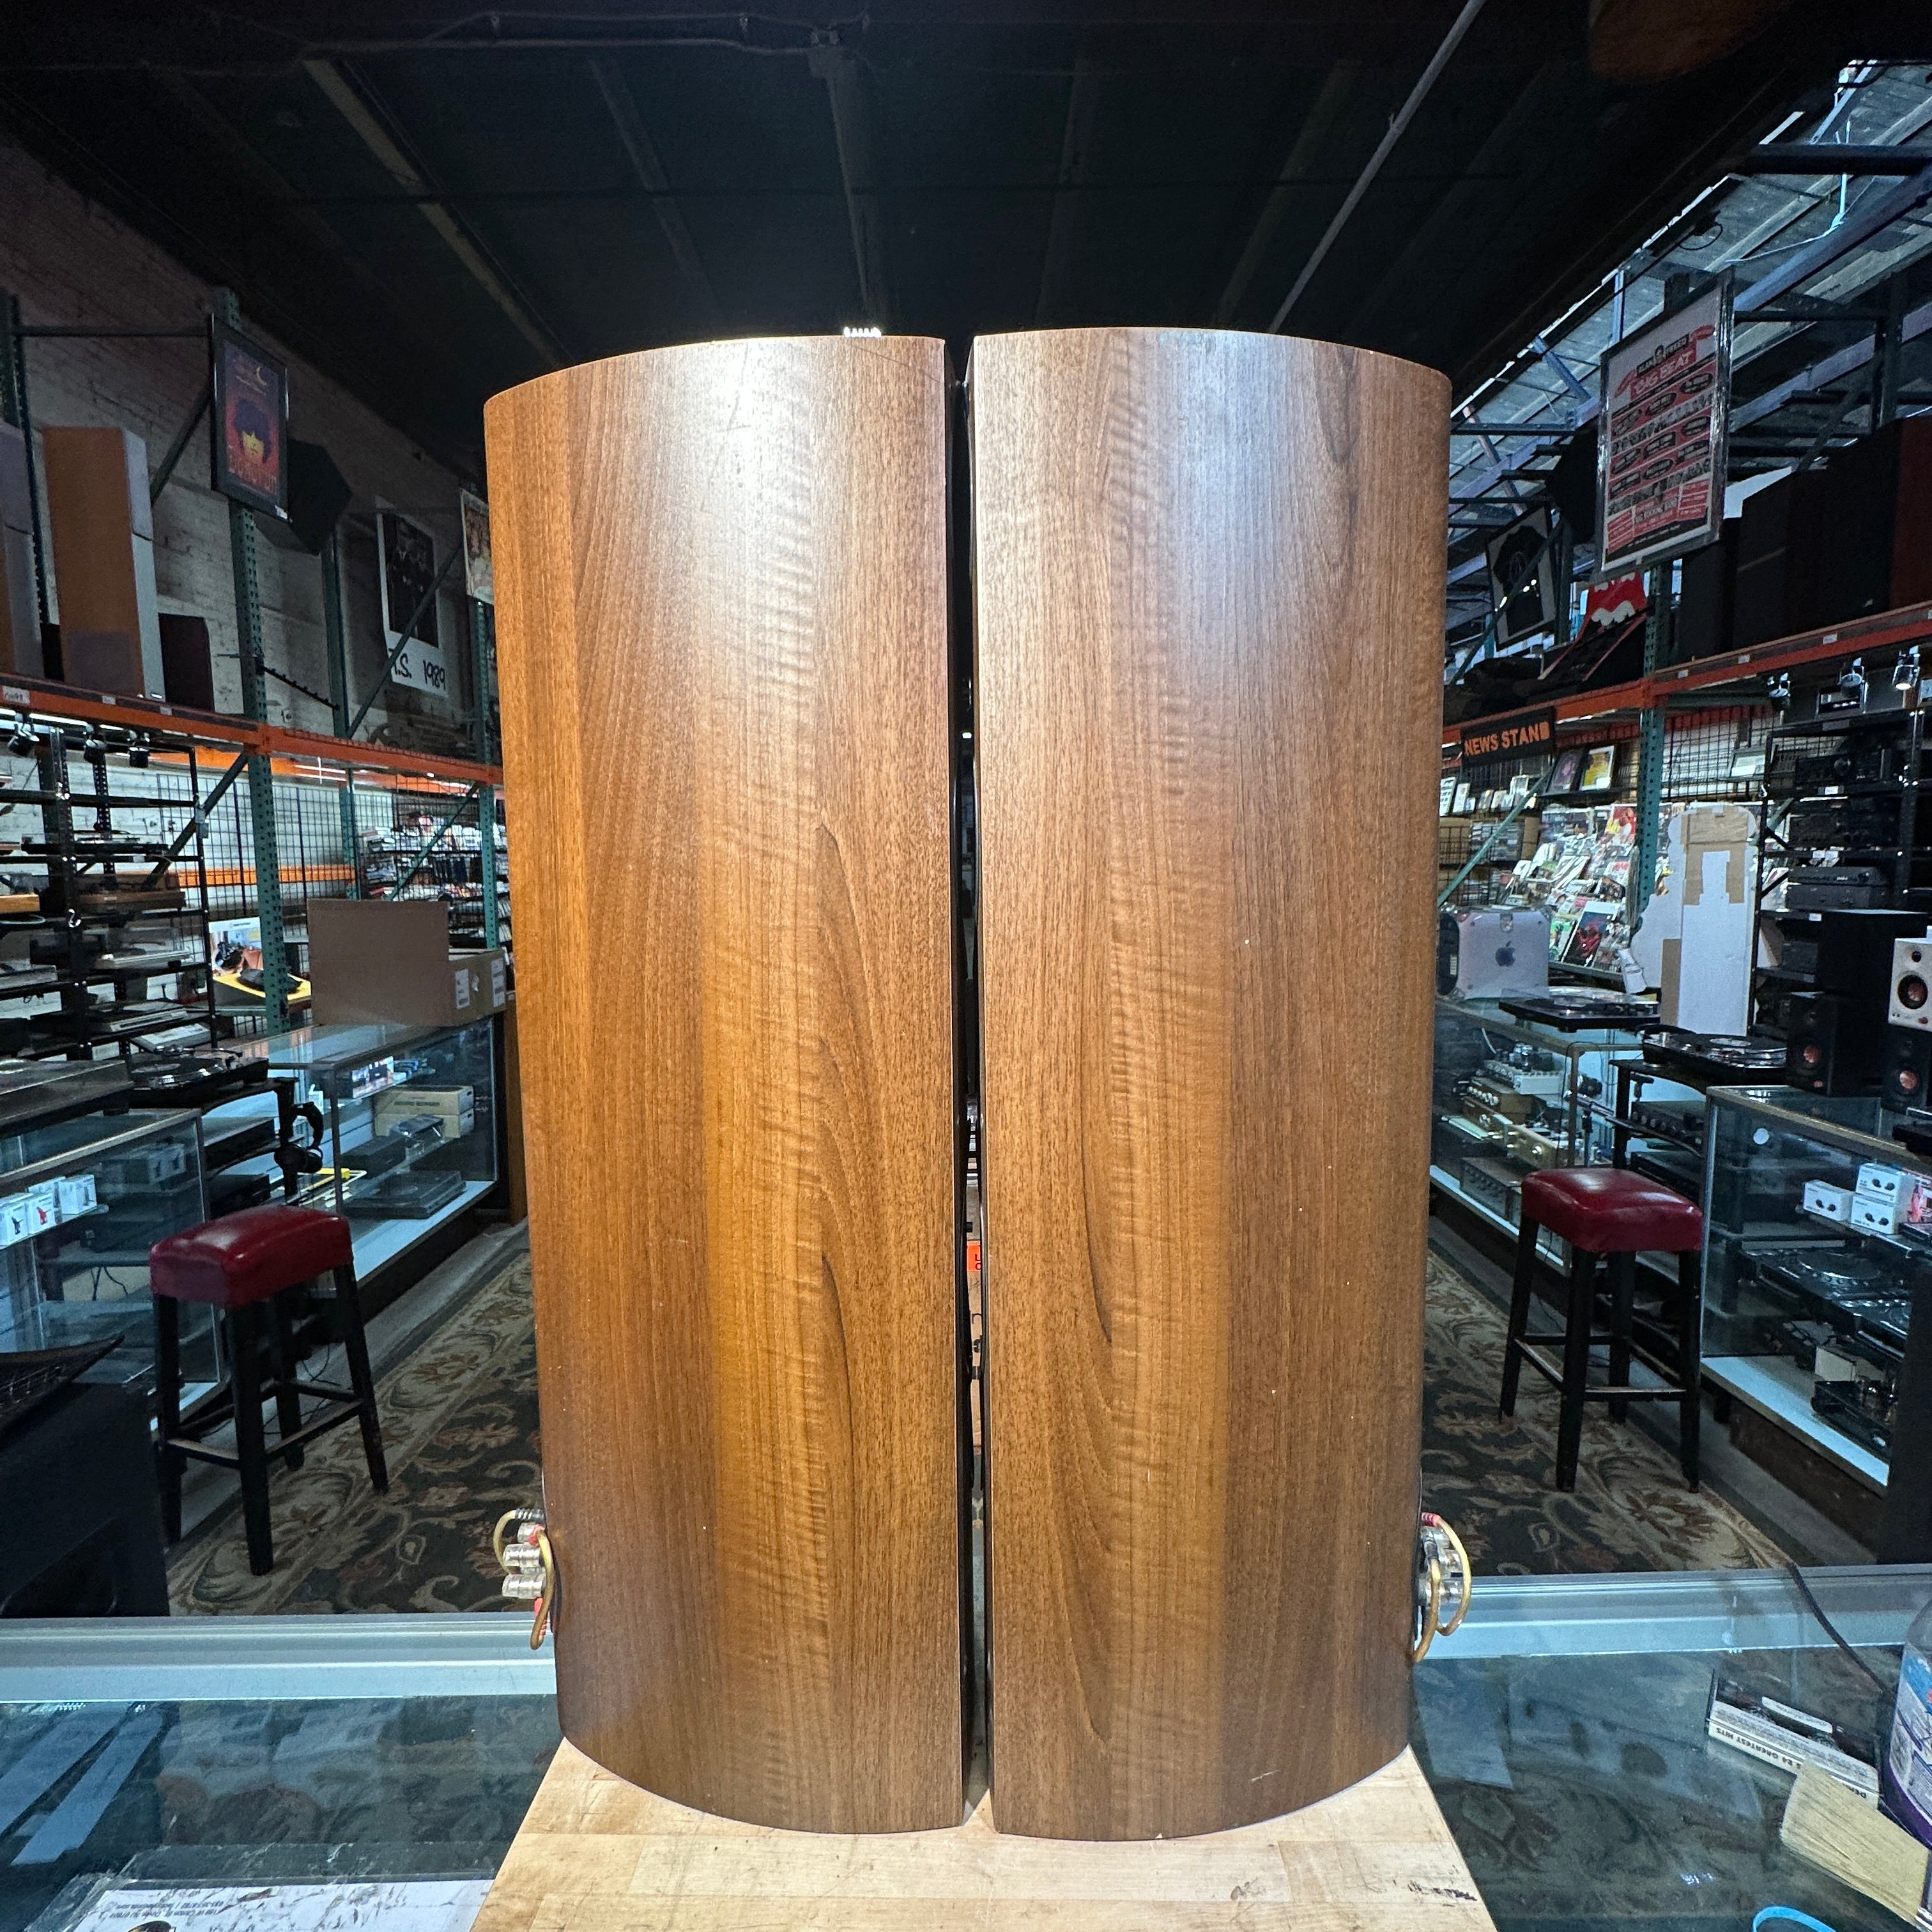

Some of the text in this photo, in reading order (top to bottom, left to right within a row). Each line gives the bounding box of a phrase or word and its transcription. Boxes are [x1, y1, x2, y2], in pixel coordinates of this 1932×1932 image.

[423, 659, 446, 691] 1989
[1464, 721, 1550, 756] NEWS STAND
[1716, 1727, 1734, 1740] HITS
[1736, 1736, 1779, 1759] GREATEST
